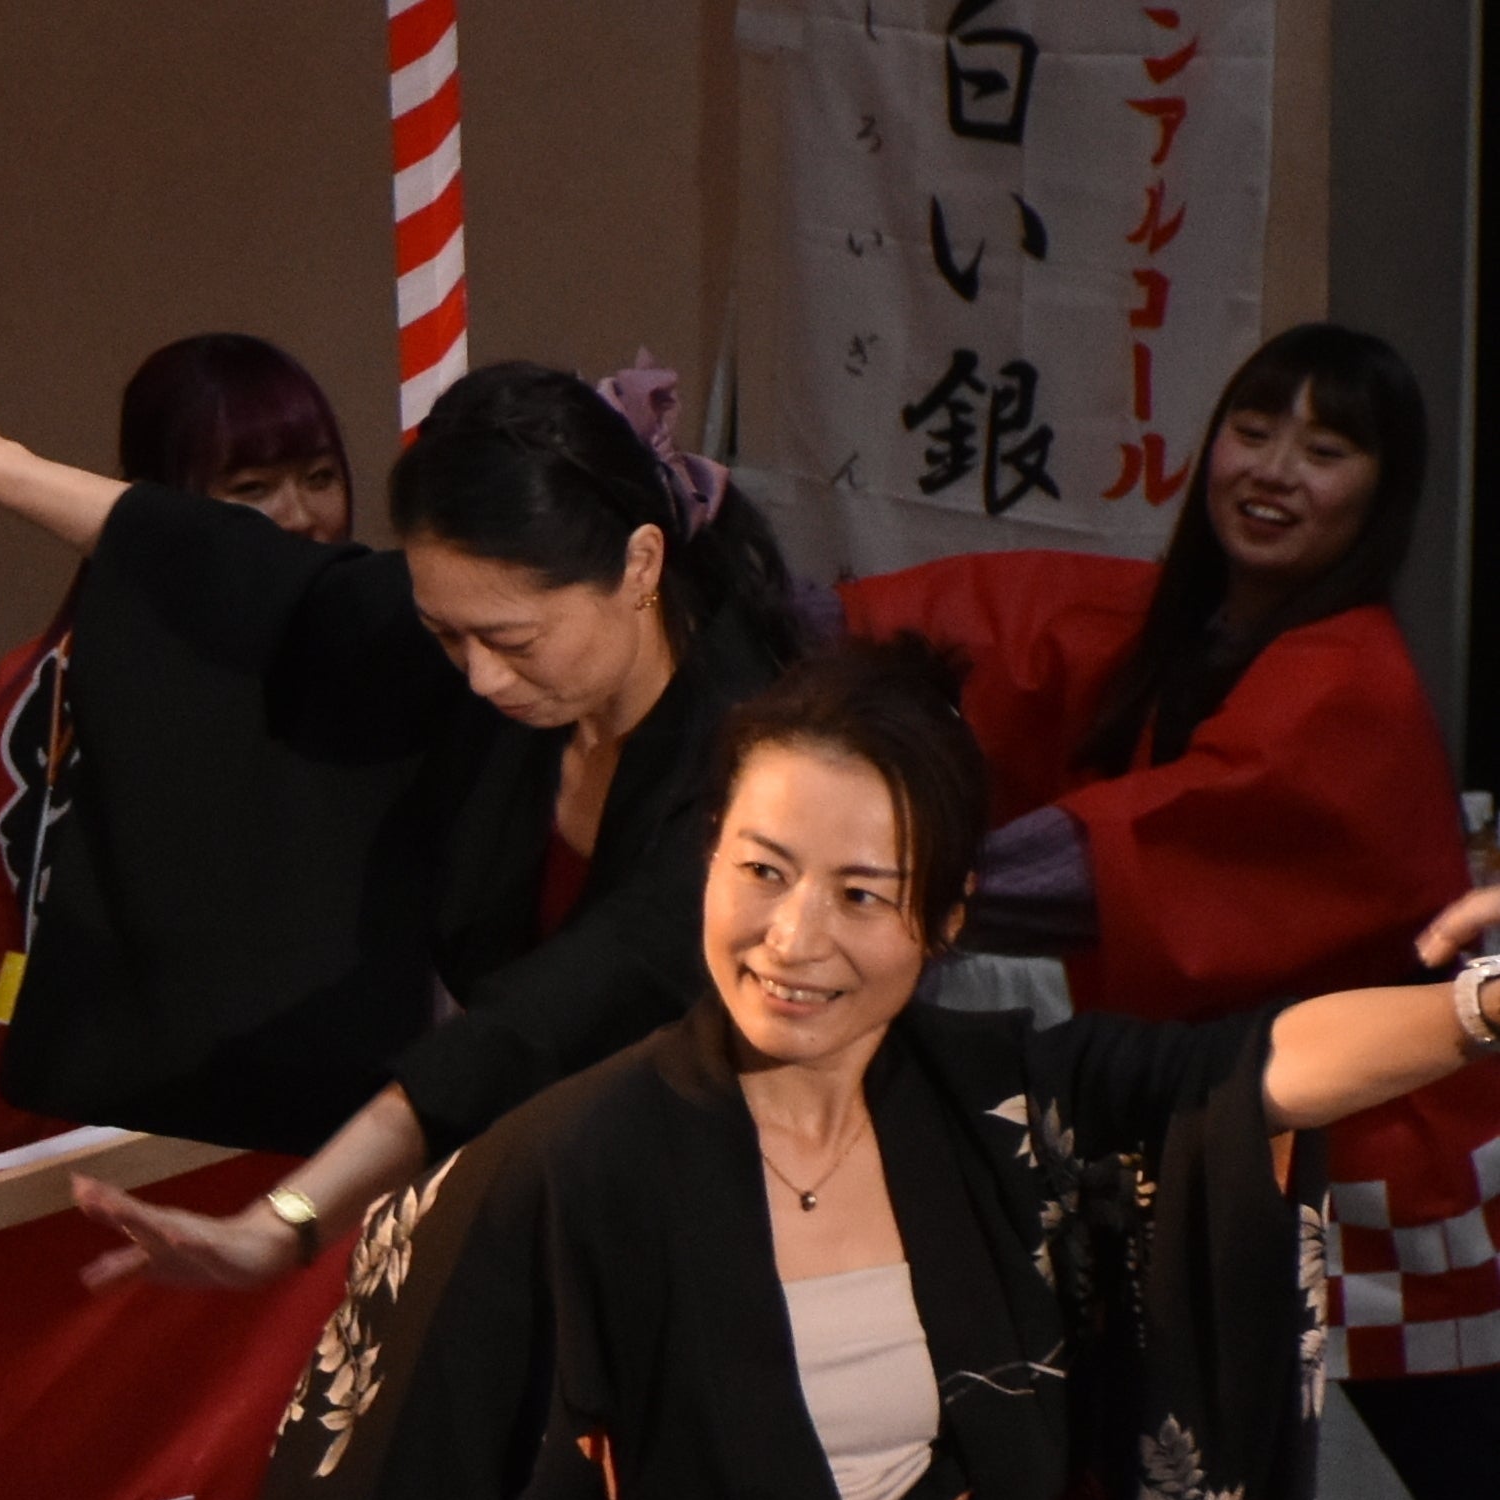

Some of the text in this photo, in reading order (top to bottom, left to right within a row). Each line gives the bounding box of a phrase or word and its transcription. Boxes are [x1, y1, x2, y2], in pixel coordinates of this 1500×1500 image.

[1102, 7, 1197, 507] ンアルコール
